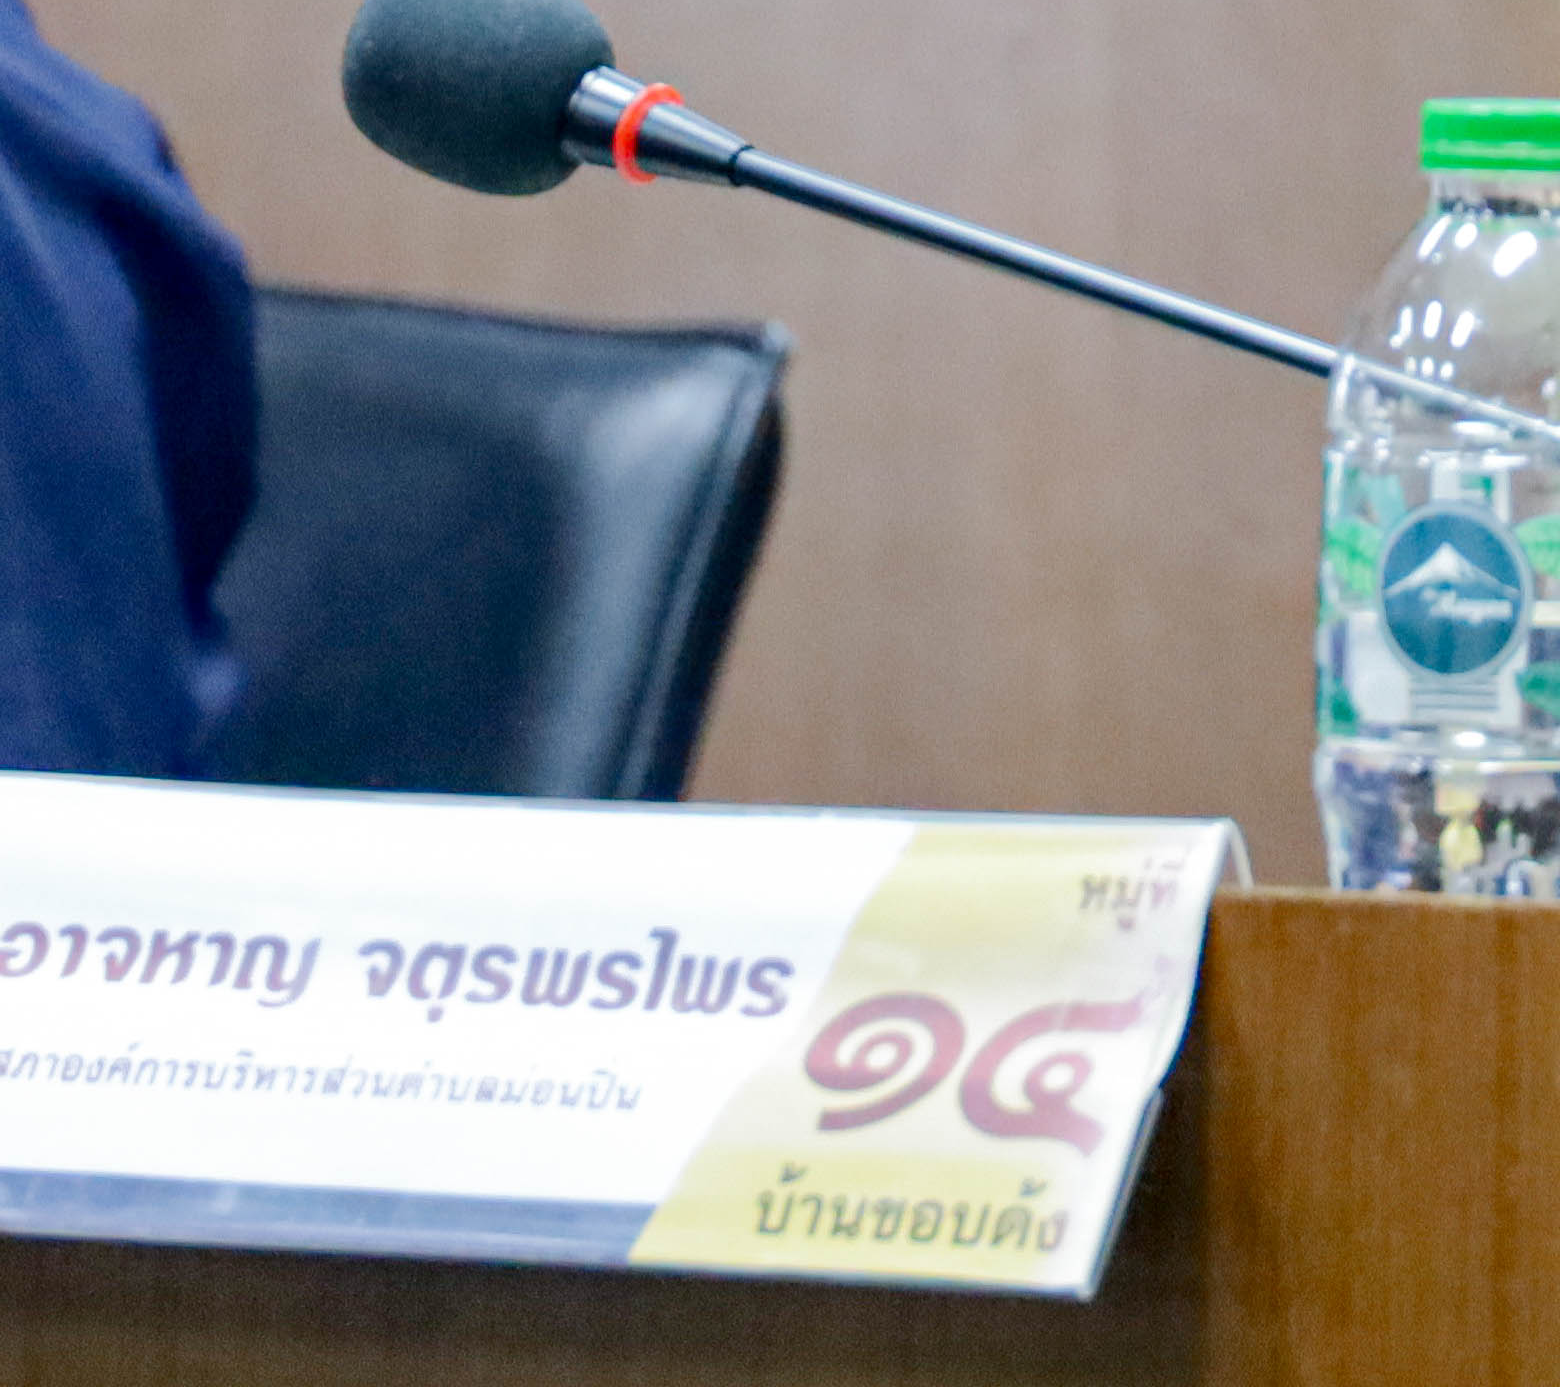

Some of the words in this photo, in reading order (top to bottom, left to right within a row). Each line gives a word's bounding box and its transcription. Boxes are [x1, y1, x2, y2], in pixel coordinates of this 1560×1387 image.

[804, 962, 1170, 1158] ๑๔
[754, 1162, 1070, 1253] บ้านขอบด้ง
